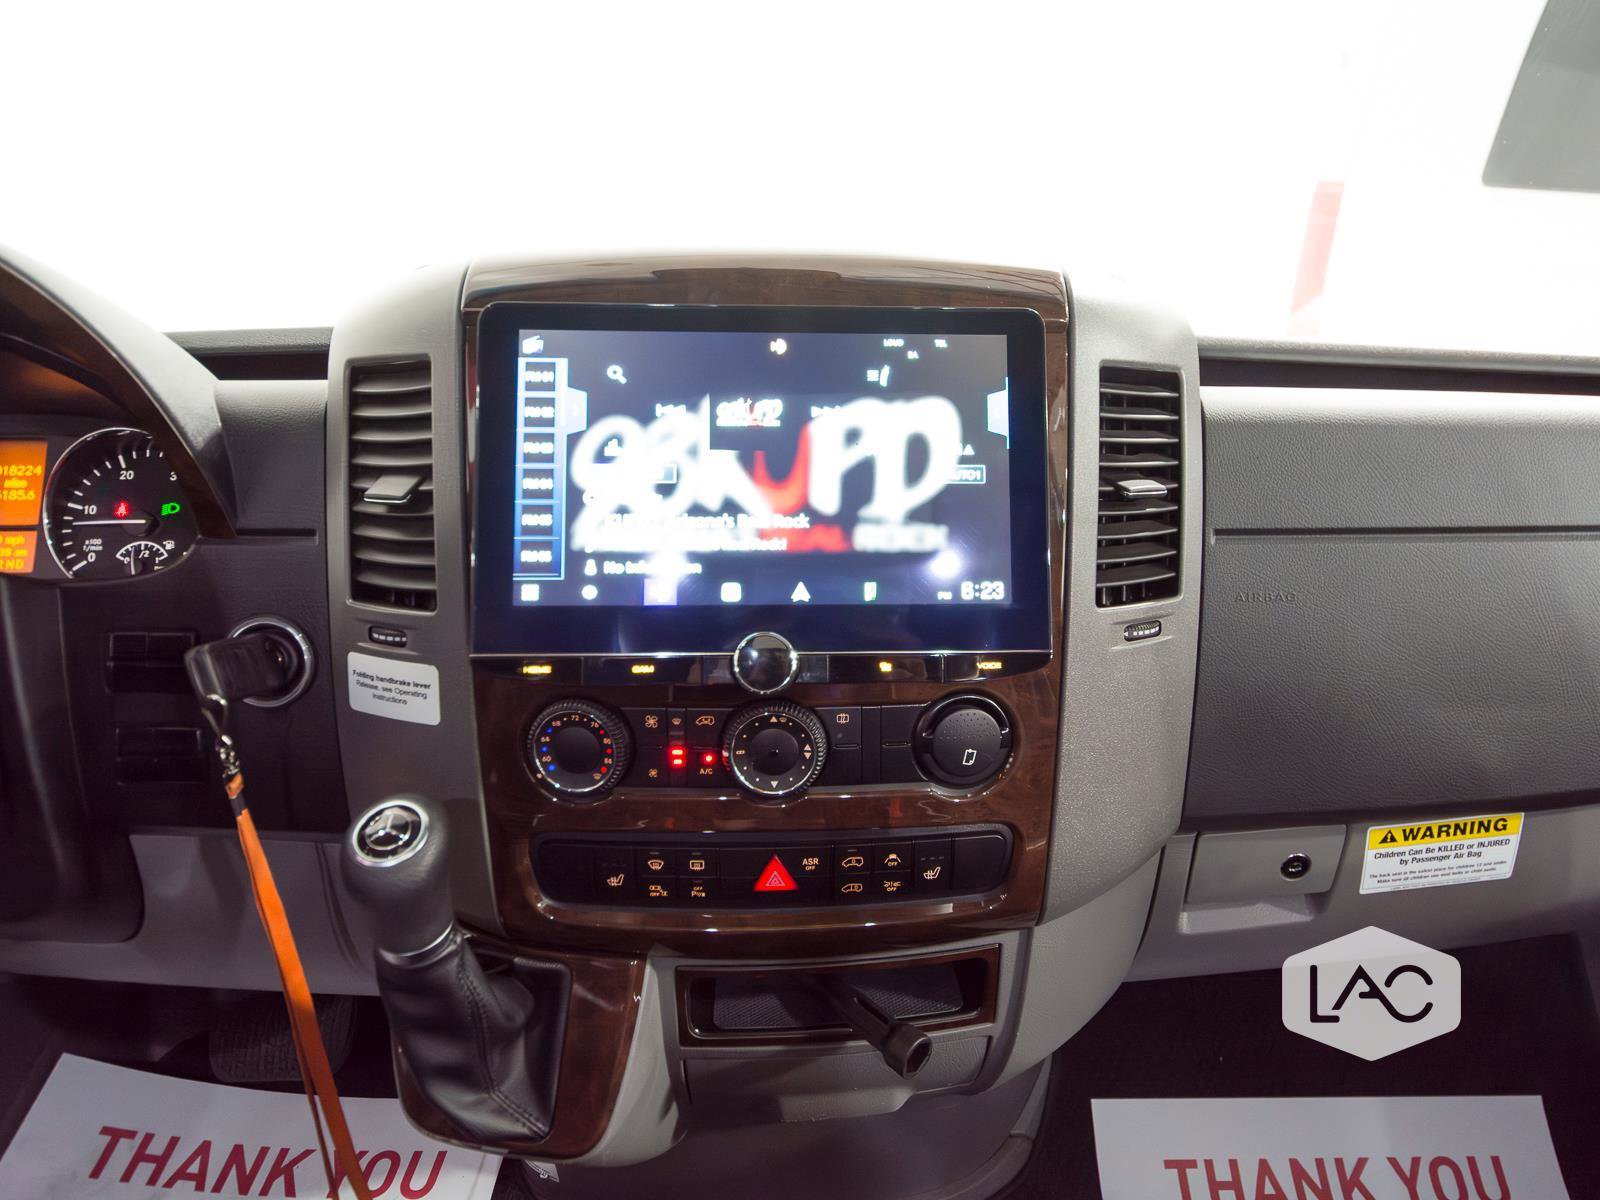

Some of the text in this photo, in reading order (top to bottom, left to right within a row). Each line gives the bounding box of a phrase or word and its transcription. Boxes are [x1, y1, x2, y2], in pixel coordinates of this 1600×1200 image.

[119, 470, 135, 480] 20
[84, 505, 97, 515] 10
[960, 580, 1005, 600] 6:23
[394, 687, 428, 700] Operating
[1402, 817, 1508, 842] WARNING
[1374, 838, 1511, 860] Children Can Be KILLED or INJURED
[1399, 850, 1482, 866] by Passenger Air Bag
[802, 857, 819, 866] ASR
[88, 1125, 448, 1200] THANK YOU
[1163, 1155, 1512, 1200] THANK YOU
